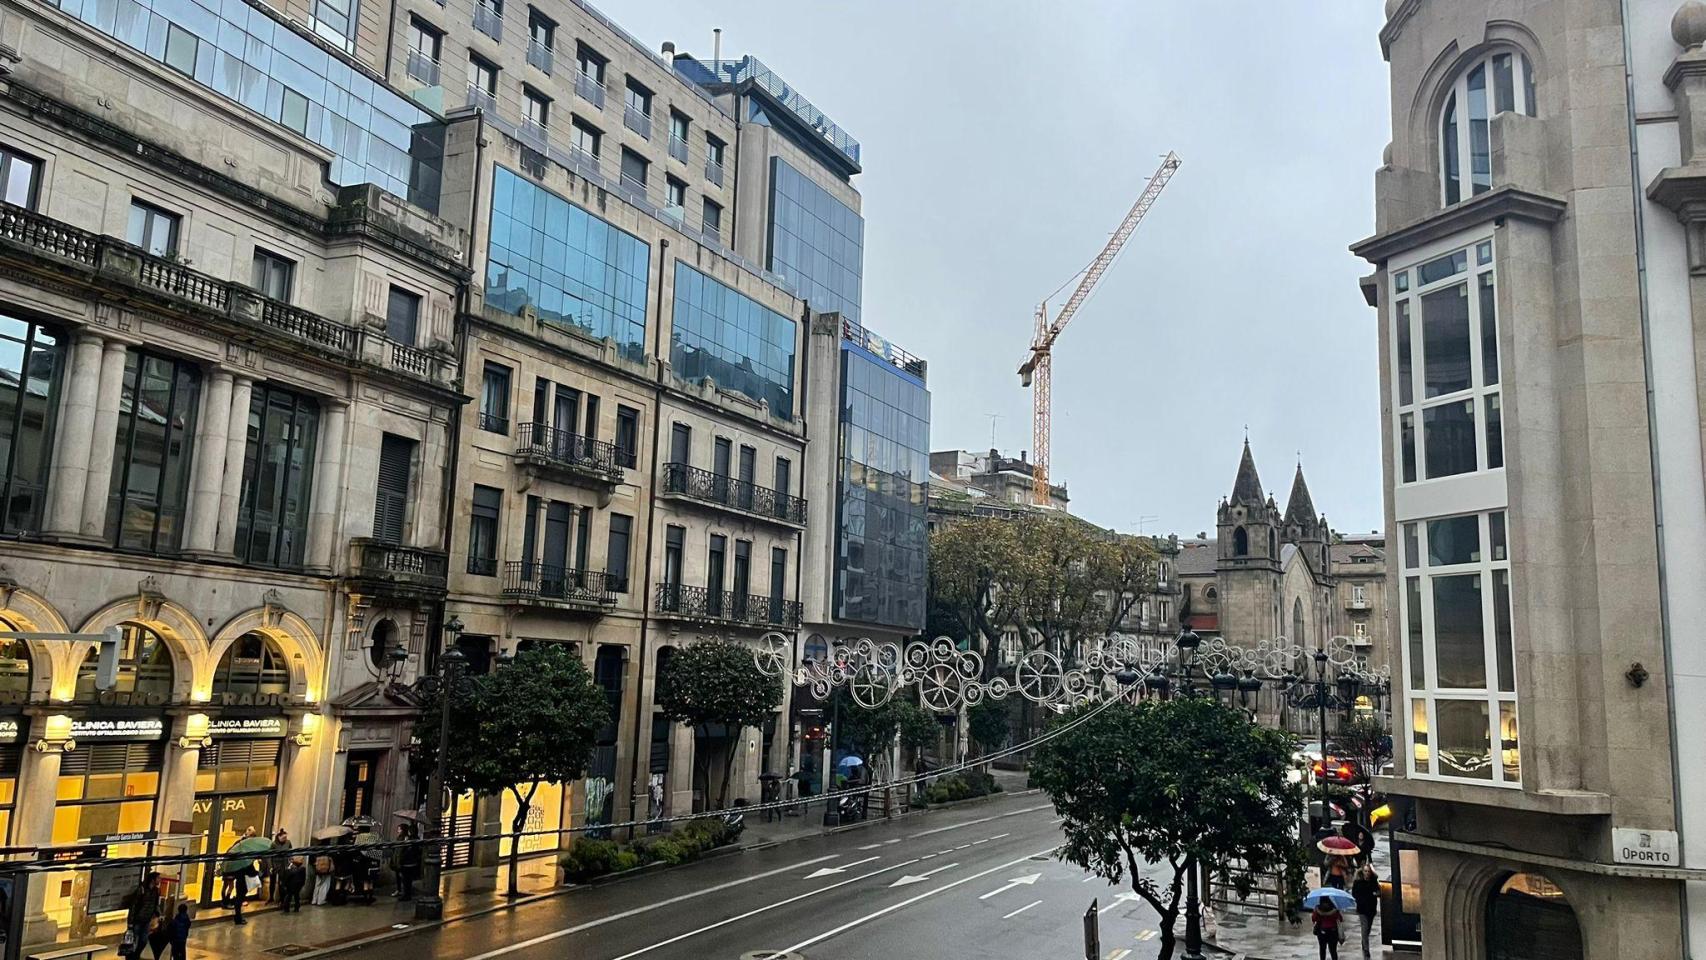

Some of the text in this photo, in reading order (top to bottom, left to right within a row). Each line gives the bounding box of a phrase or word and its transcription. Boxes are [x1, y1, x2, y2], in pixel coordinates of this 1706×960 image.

[222, 688, 291, 706] RADIO
[117, 720, 163, 730] BAVIERA
[243, 719, 281, 728] BAVIERA
[1622, 847, 1670, 862] OPORTO
